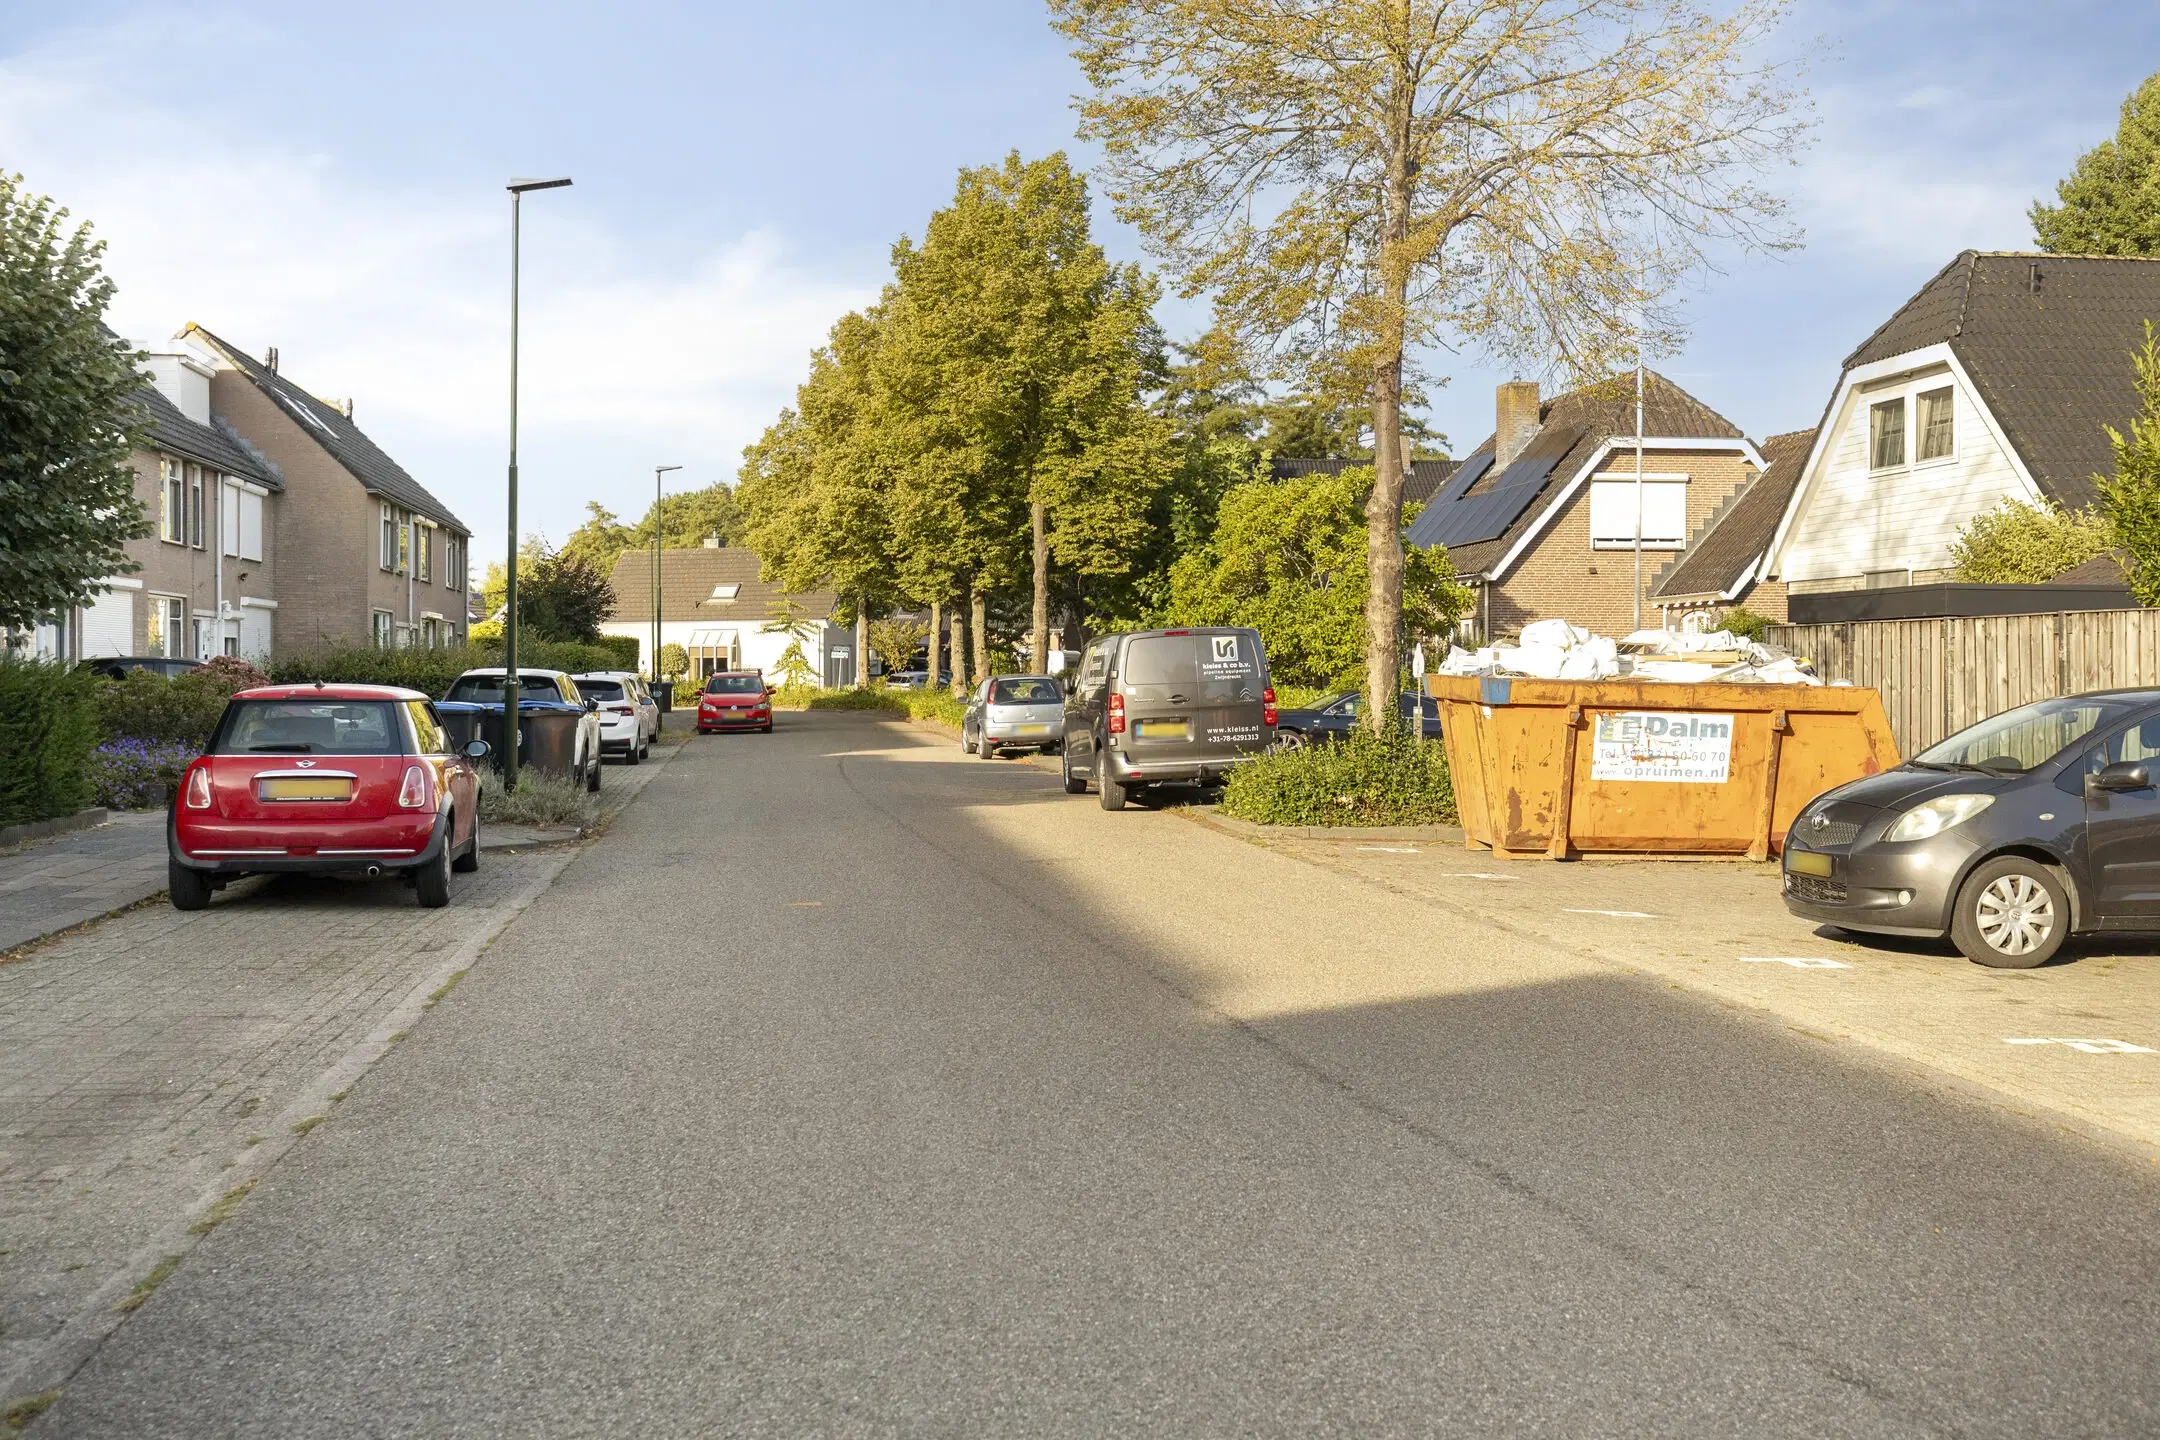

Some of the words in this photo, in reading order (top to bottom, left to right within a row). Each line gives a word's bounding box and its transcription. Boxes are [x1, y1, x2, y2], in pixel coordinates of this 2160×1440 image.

[1207, 725, 1258, 734] www.kleiss.nl
[1646, 716, 1729, 738] Dalm
[1208, 734, 1259, 742] +31-78-6291313
